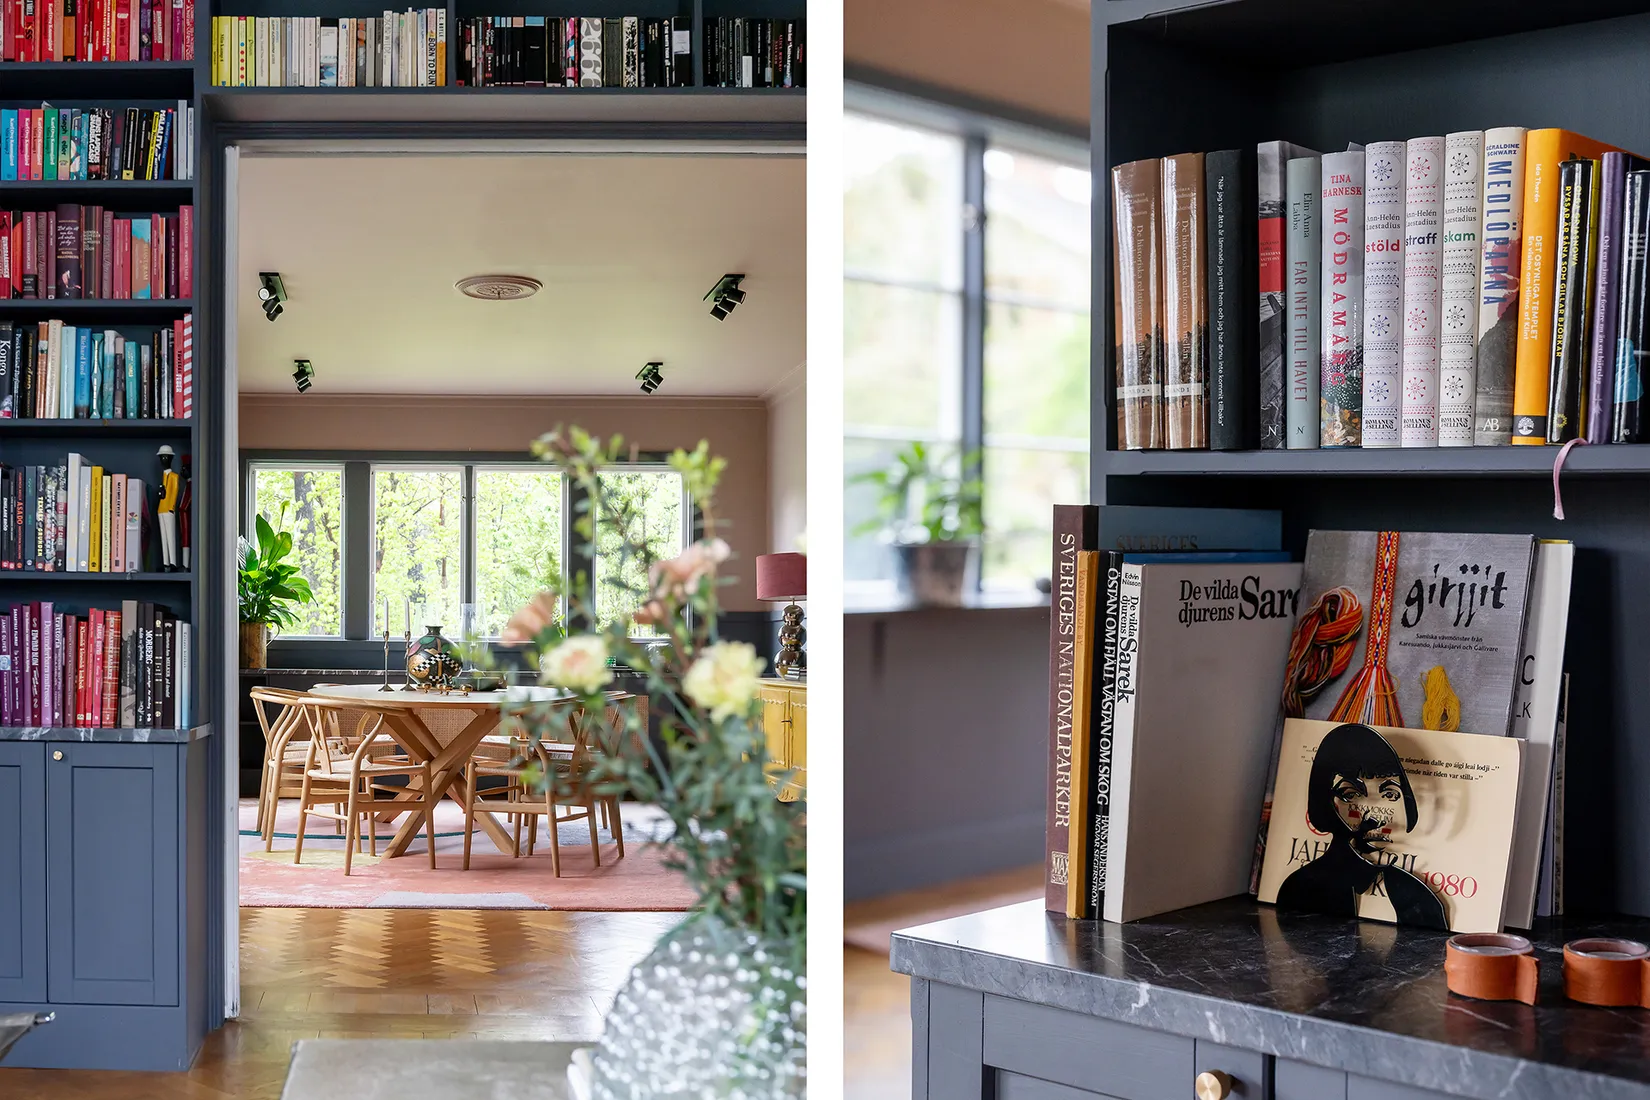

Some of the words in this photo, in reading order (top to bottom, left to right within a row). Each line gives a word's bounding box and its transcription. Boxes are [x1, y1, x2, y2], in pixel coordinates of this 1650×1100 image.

[428, 38, 436, 57] BORN
[428, 59, 436, 69] TO
[428, 70, 436, 86] RUN
[1331, 174, 1351, 184] TINA
[1303, 193, 1312, 211] Elin
[1323, 187, 1362, 198] HARNESK
[1563, 186, 1572, 219] RYSSAR
[1182, 220, 1190, 233] De
[1292, 202, 1300, 230] Labba
[1303, 214, 1312, 238] Anna
[1366, 222, 1400, 230] Laestadius
[1406, 219, 1437, 227] Laestadius
[1444, 215, 1476, 223] Laestadius
[1136, 225, 1144, 237] De
[1405, 232, 1437, 247] straff
[1444, 231, 1475, 243] skam
[1484, 160, 1517, 305] MEDLÖPARNA
[1528, 235, 1534, 245] En
[1535, 235, 1543, 252] DET
[1136, 239, 1144, 278] historiska
[1182, 236, 1190, 275] historiska
[1366, 239, 1400, 253] stöld
[1561, 235, 1571, 258] SÅNA
[1294, 261, 1307, 284] FAR
[1532, 254, 1542, 298] OSYNLIGA
[1560, 261, 1568, 281] SOM
[1182, 278, 1190, 327] relationerna
[1294, 292, 1307, 320] INTE
[1332, 208, 1350, 385] MÖDRAMÄRG
[1524, 286, 1532, 309] Hilma
[1558, 283, 1567, 315] GILLAR
[1530, 300, 1540, 340] TEMPLET
[80, 335, 88, 360] Richard
[1294, 327, 1307, 354] TILL
[1555, 317, 1566, 357] BJÖRKAR
[0, 340, 11, 376] Kongo
[1294, 361, 1308, 401] HAVET
[1058, 534, 1076, 635] SVERIGES
[1122, 579, 1141, 587] Nilsson
[1124, 572, 1139, 580] Edvin
[1106, 567, 1120, 616] ÖSTAN
[1129, 595, 1139, 610] De
[1179, 579, 1201, 601] De
[1204, 579, 1239, 601] vilda
[1401, 563, 1507, 628] girjjit
[1118, 595, 1130, 634] djurens
[1127, 611, 1138, 637] vilda
[1178, 602, 1235, 626] djurens
[43, 620, 51, 637] Den
[1105, 618, 1116, 643] OM
[43, 637, 51, 674] underbara
[145, 629, 153, 664] MORBERG
[1103, 646, 1117, 682] FJÄLL
[1116, 636, 1138, 703] Sarek
[43, 674, 51, 707] matresan
[1100, 684, 1115, 736] VÄSTAN
[1055, 641, 1075, 828] NATIONALPARKER
[1099, 738, 1111, 763] OM
[1097, 765, 1110, 805] SKOG
[1094, 814, 1102, 846] INGVAR
[1101, 815, 1110, 839] HANS
[1422, 871, 1478, 899] 1980
